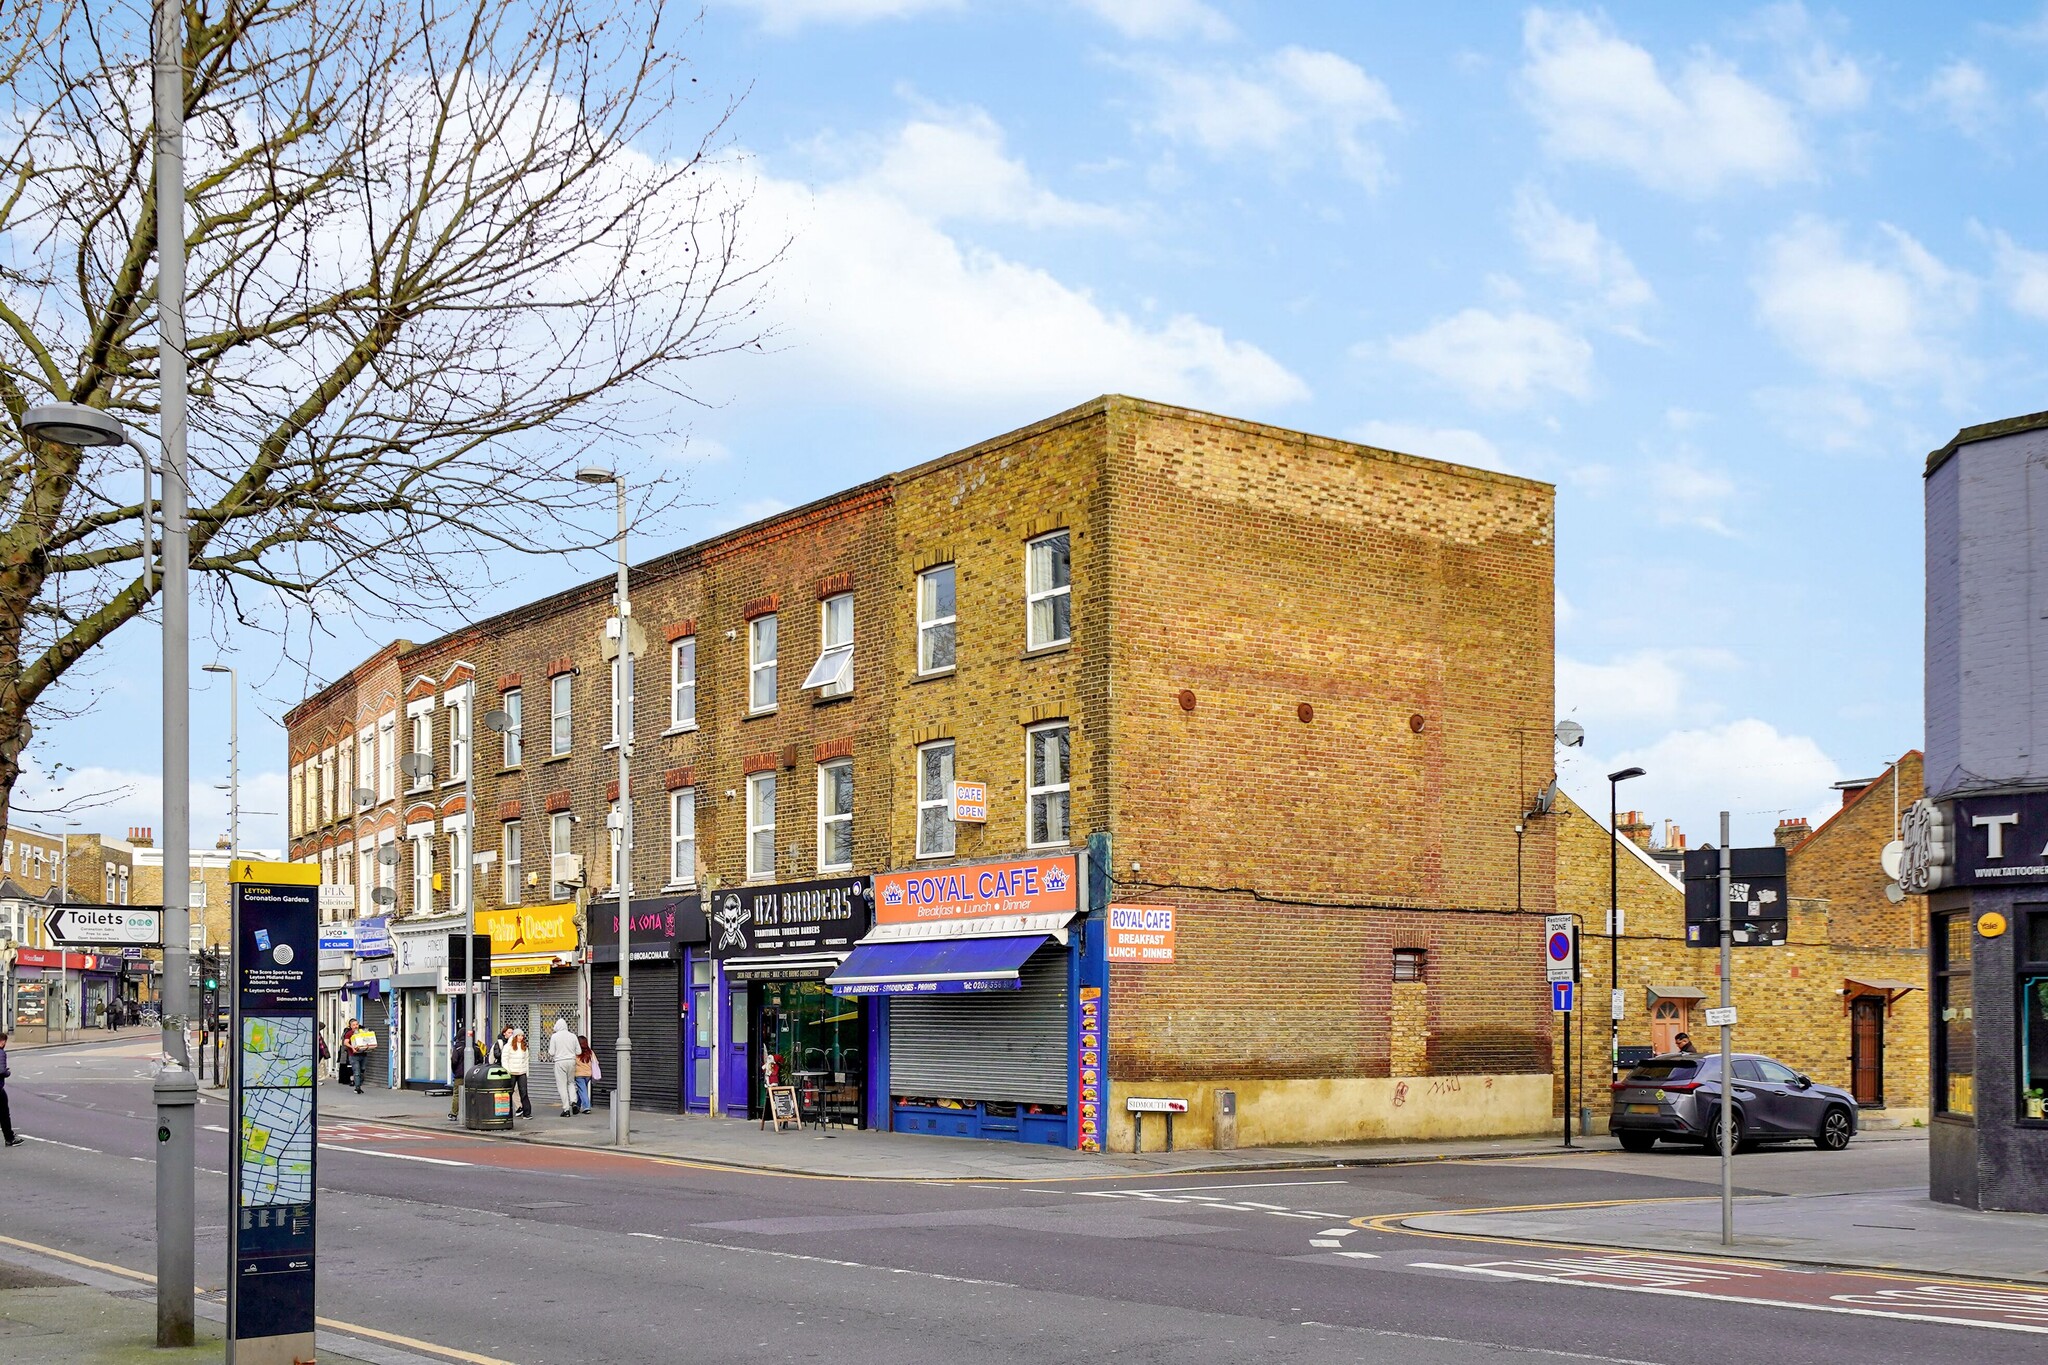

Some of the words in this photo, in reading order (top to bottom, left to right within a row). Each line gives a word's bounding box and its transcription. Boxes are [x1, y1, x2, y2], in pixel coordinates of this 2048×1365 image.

[957, 787, 982, 801] CAFE
[958, 806, 984, 817] OPEN
[1971, 812, 2048, 859] T
[324, 887, 346, 896] FLK
[907, 874, 974, 905] ROYAL
[978, 866, 1039, 900] CAFE
[244, 894, 282, 902] Coronation
[319, 898, 353, 906] Solicitors
[917, 905, 954, 919] Breakfast
[963, 901, 992, 913] Lunch
[1002, 899, 1032, 911] Dinner
[68, 912, 123, 925] Toilets
[613, 915, 636, 933] BA
[1112, 910, 1143, 928] ROYAL
[1146, 911, 1170, 929] CAFE
[487, 916, 516, 942] Palm
[524, 914, 565, 940] Desert
[1551, 923, 1567, 931] ZONE
[1980, 921, 1998, 930] Yale
[325, 929, 343, 938] Lyca
[754, 928, 781, 938] TRADITIONAL
[800, 926, 821, 935] BARBERS
[1118, 934, 1165, 944] BREAKFAST
[1108, 946, 1137, 957] LUNCH
[1142, 948, 1172, 959] DINNER
[1128, 1101, 1167, 1109] SIDMOUTH
